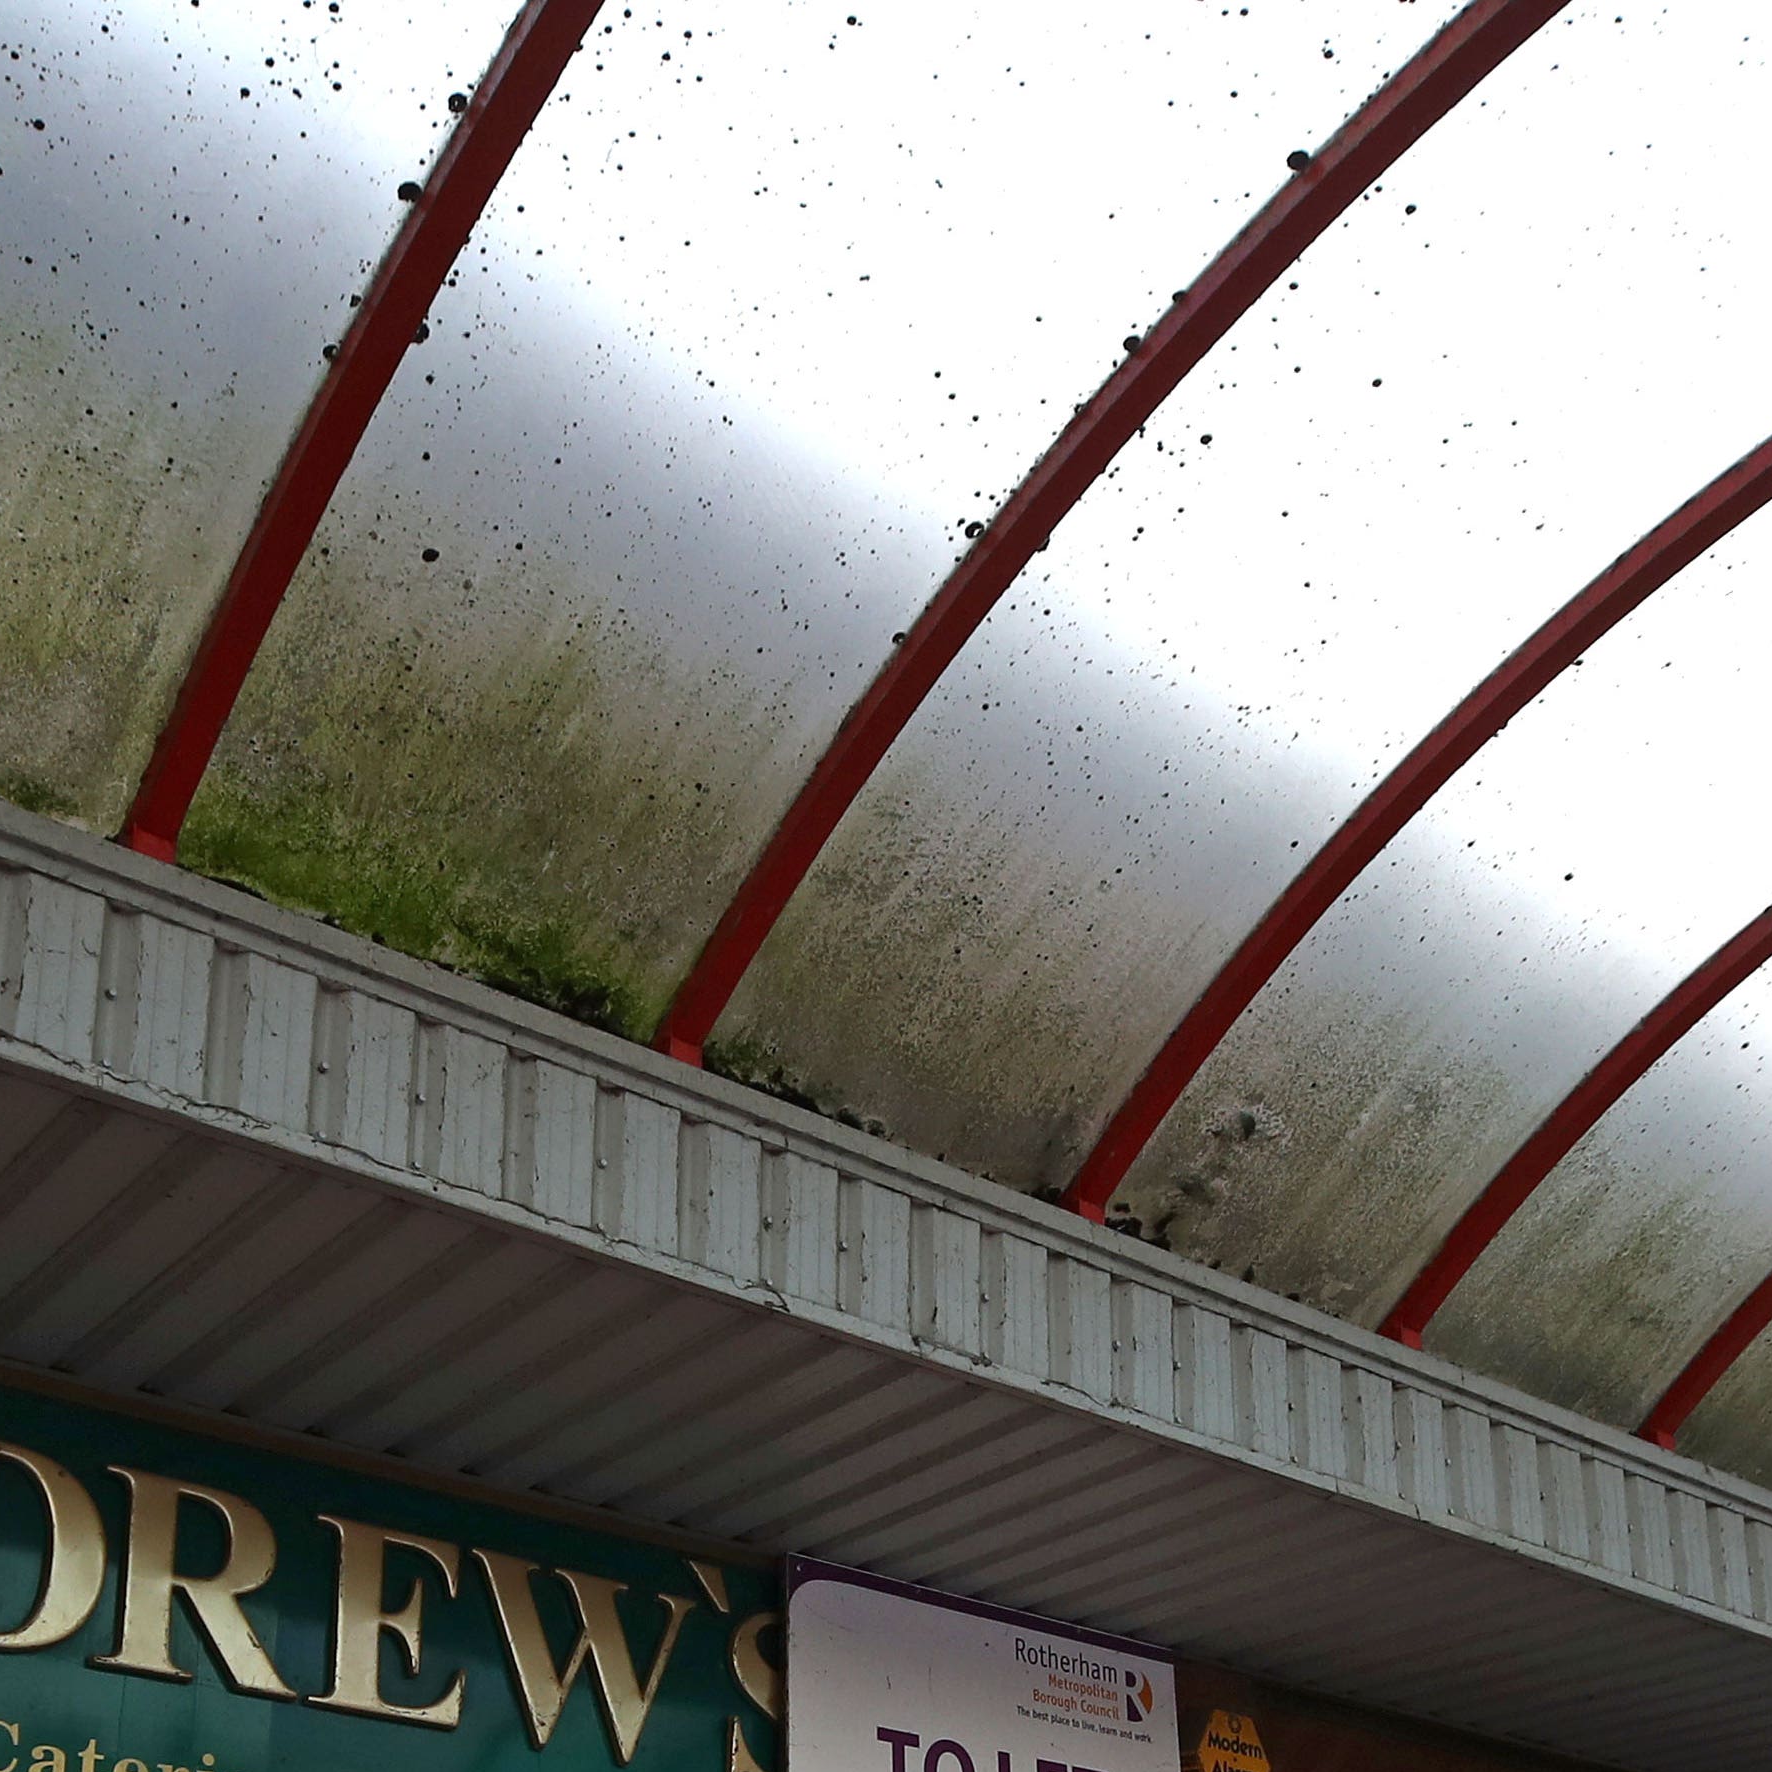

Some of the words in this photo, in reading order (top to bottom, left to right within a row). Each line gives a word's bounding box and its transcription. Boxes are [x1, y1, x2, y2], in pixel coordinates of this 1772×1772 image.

[1014, 1636, 1119, 1685] Rotherham
[1048, 1673, 1119, 1702] Metropolitan
[1032, 1688, 1078, 1713] Borough
[1079, 1699, 1121, 1721] Council
[1207, 1730, 1263, 1760] Modern
